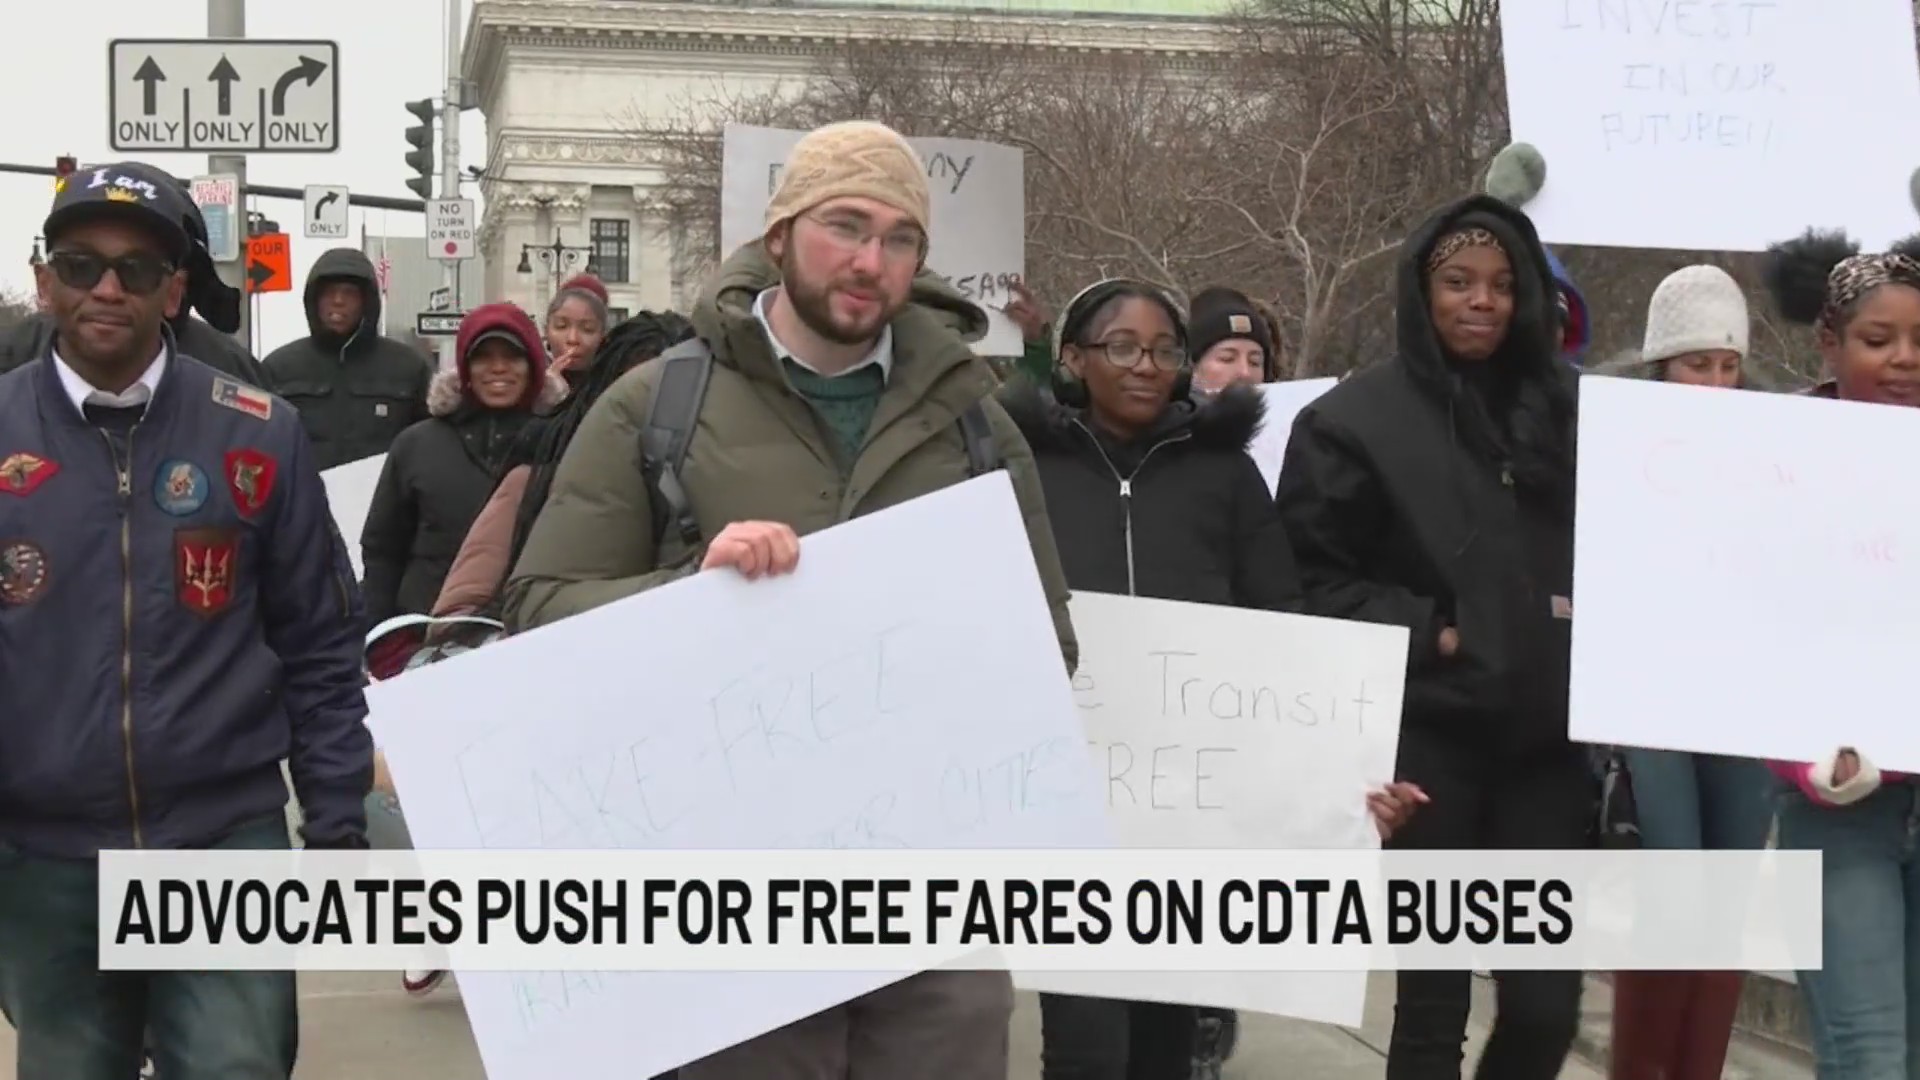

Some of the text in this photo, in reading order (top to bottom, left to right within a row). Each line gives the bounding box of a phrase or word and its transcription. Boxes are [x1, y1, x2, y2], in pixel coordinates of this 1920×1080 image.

[1559, 0, 1778, 39] INVEST
[1623, 61, 1787, 96] IN OUR
[119, 121, 179, 142] ONLY
[194, 121, 254, 142] ONLY
[268, 121, 329, 142] ONLY
[88, 168, 157, 200] I am
[440, 203, 460, 214] NO
[310, 223, 342, 234] ONLY
[437, 218, 464, 226] TURN
[431, 230, 471, 239] ON RED
[1147, 650, 1374, 736] Transit
[1088, 741, 1238, 810] REE
